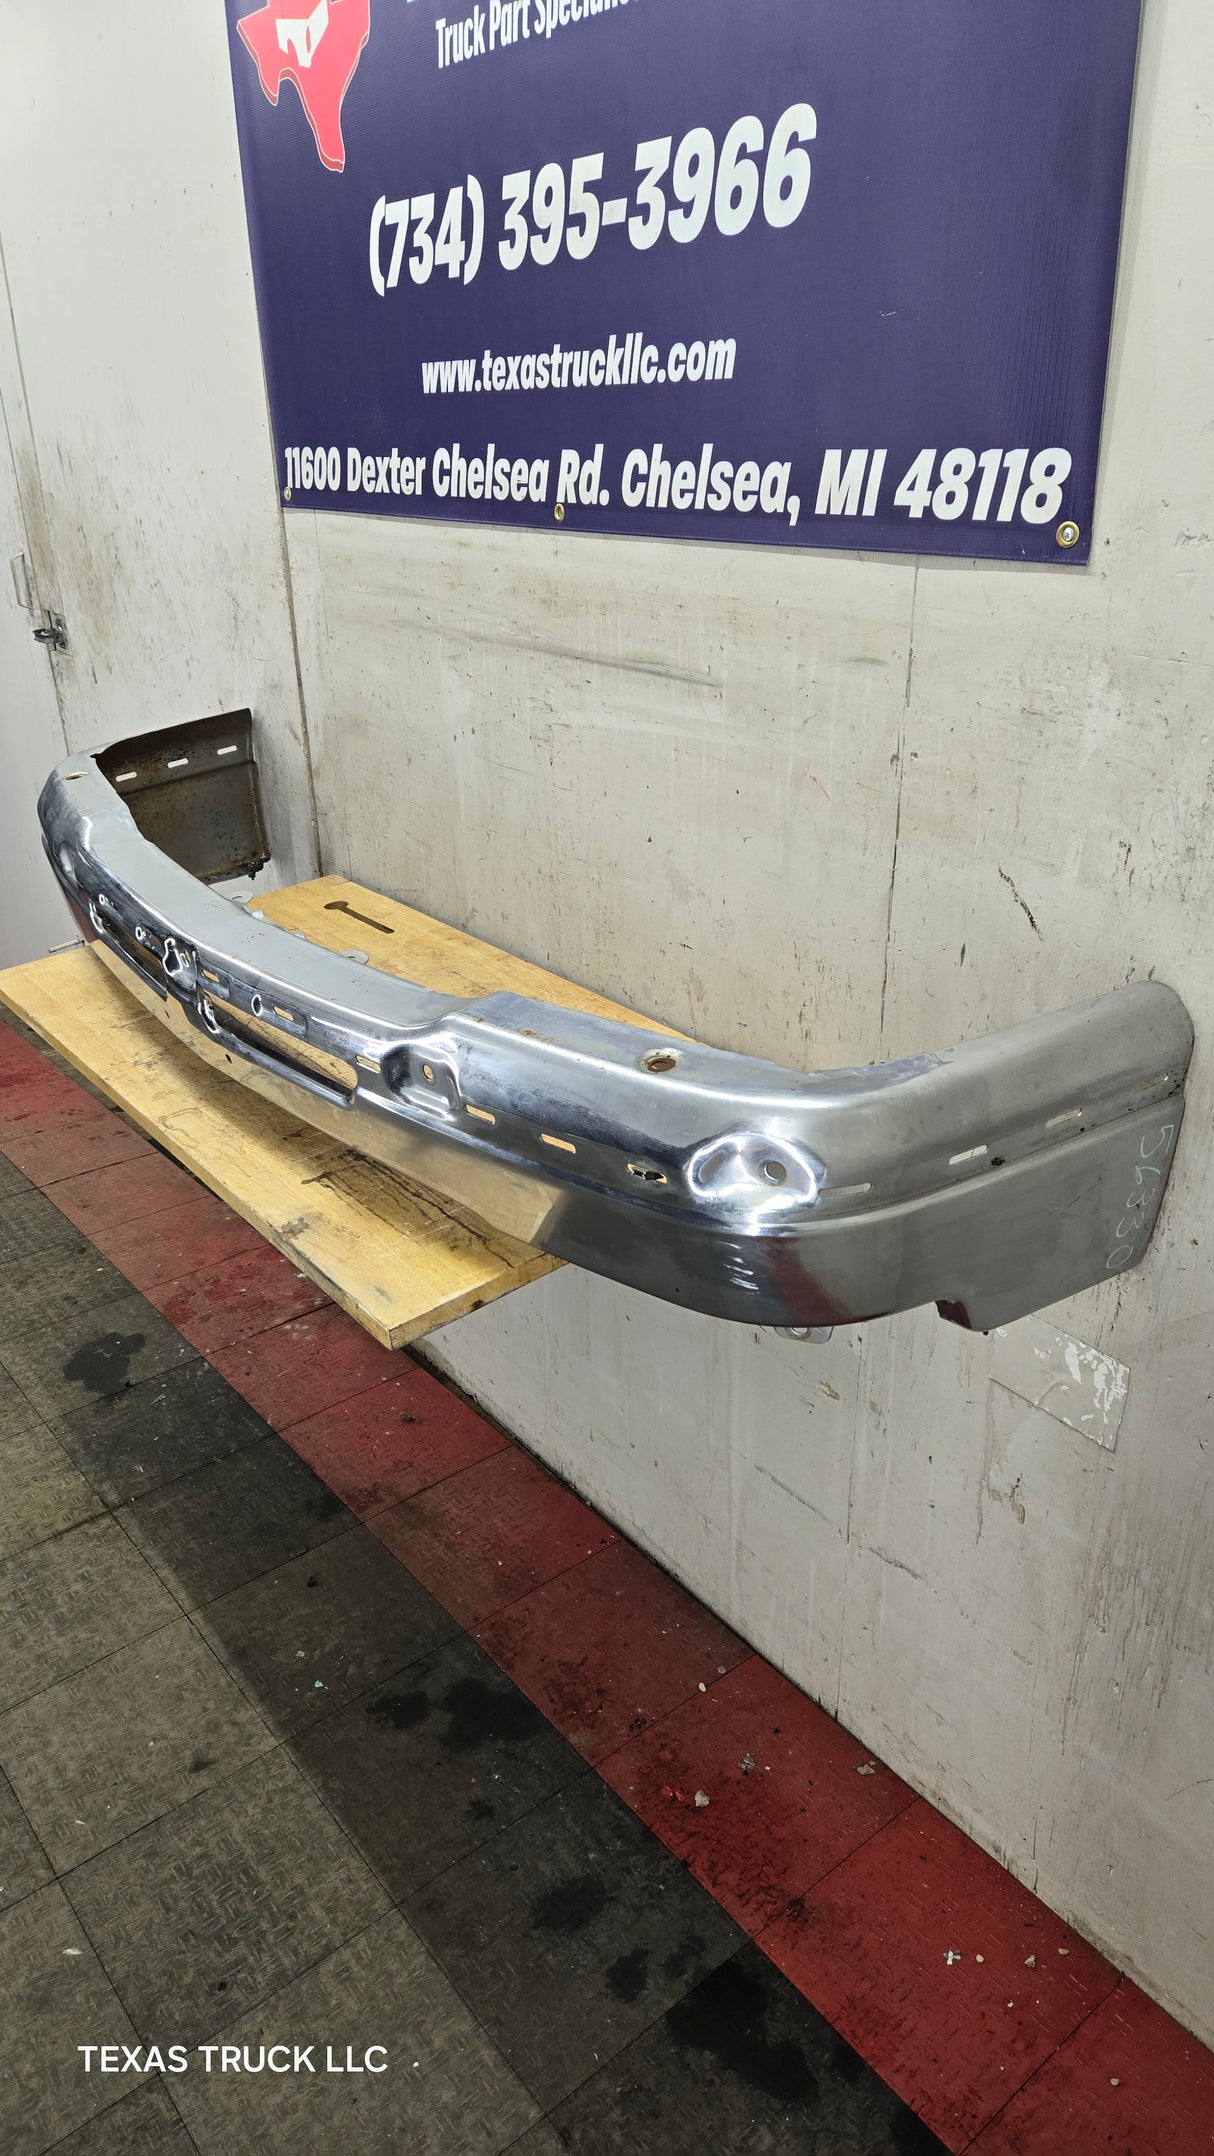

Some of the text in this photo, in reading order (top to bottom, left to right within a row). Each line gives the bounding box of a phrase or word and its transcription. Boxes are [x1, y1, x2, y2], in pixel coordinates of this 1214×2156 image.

[435, 4, 486, 69] Truck
[489, 0, 531, 51] Part
[369, 101, 817, 297] (734) 395-3966
[421, 331, 737, 394] www.texastruckllc.com
[284, 443, 1072, 527] 11600 Dexter Chelsea Rd. Chelsea, MI 48118
[1105, 1123, 1176, 1270] 56330
